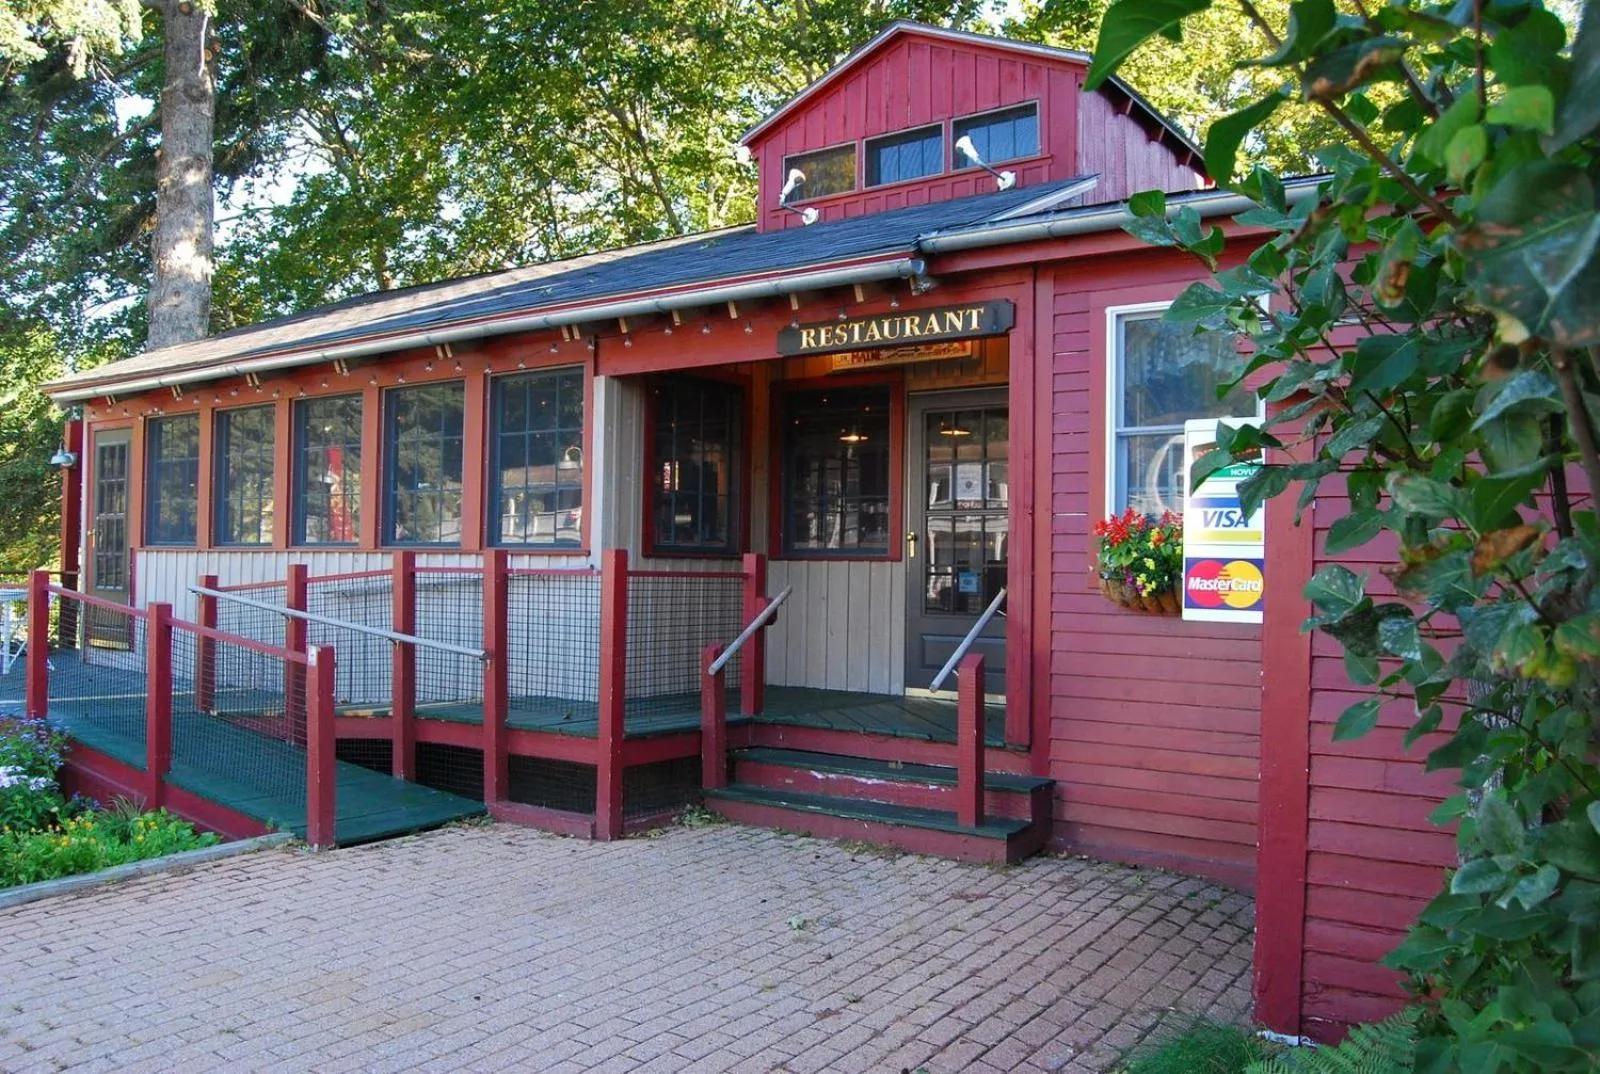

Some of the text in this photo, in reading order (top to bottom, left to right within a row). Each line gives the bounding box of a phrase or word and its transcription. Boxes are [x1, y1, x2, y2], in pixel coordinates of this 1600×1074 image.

[799, 307, 985, 350] RESTAURANT
[1202, 510, 1249, 528] VISA
[1188, 577, 1261, 592] MasterCard
